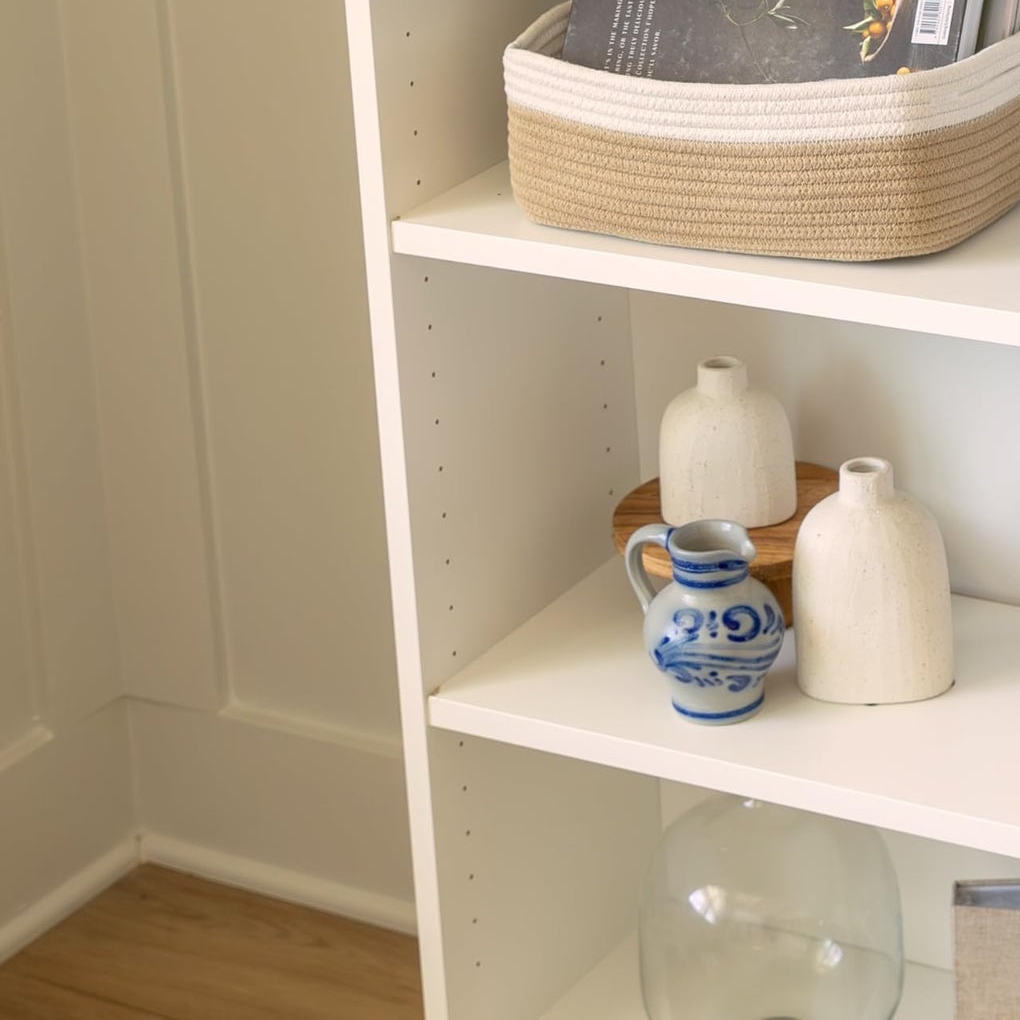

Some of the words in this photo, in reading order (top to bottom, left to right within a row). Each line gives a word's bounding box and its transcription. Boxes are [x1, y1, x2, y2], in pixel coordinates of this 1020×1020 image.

[622, 21, 630, 34] THE
[609, 31, 617, 45] THE
[620, 37, 626, 49] OR
[635, 28, 650, 76] COLLECTION
[647, 0, 656, 20] HOPE
